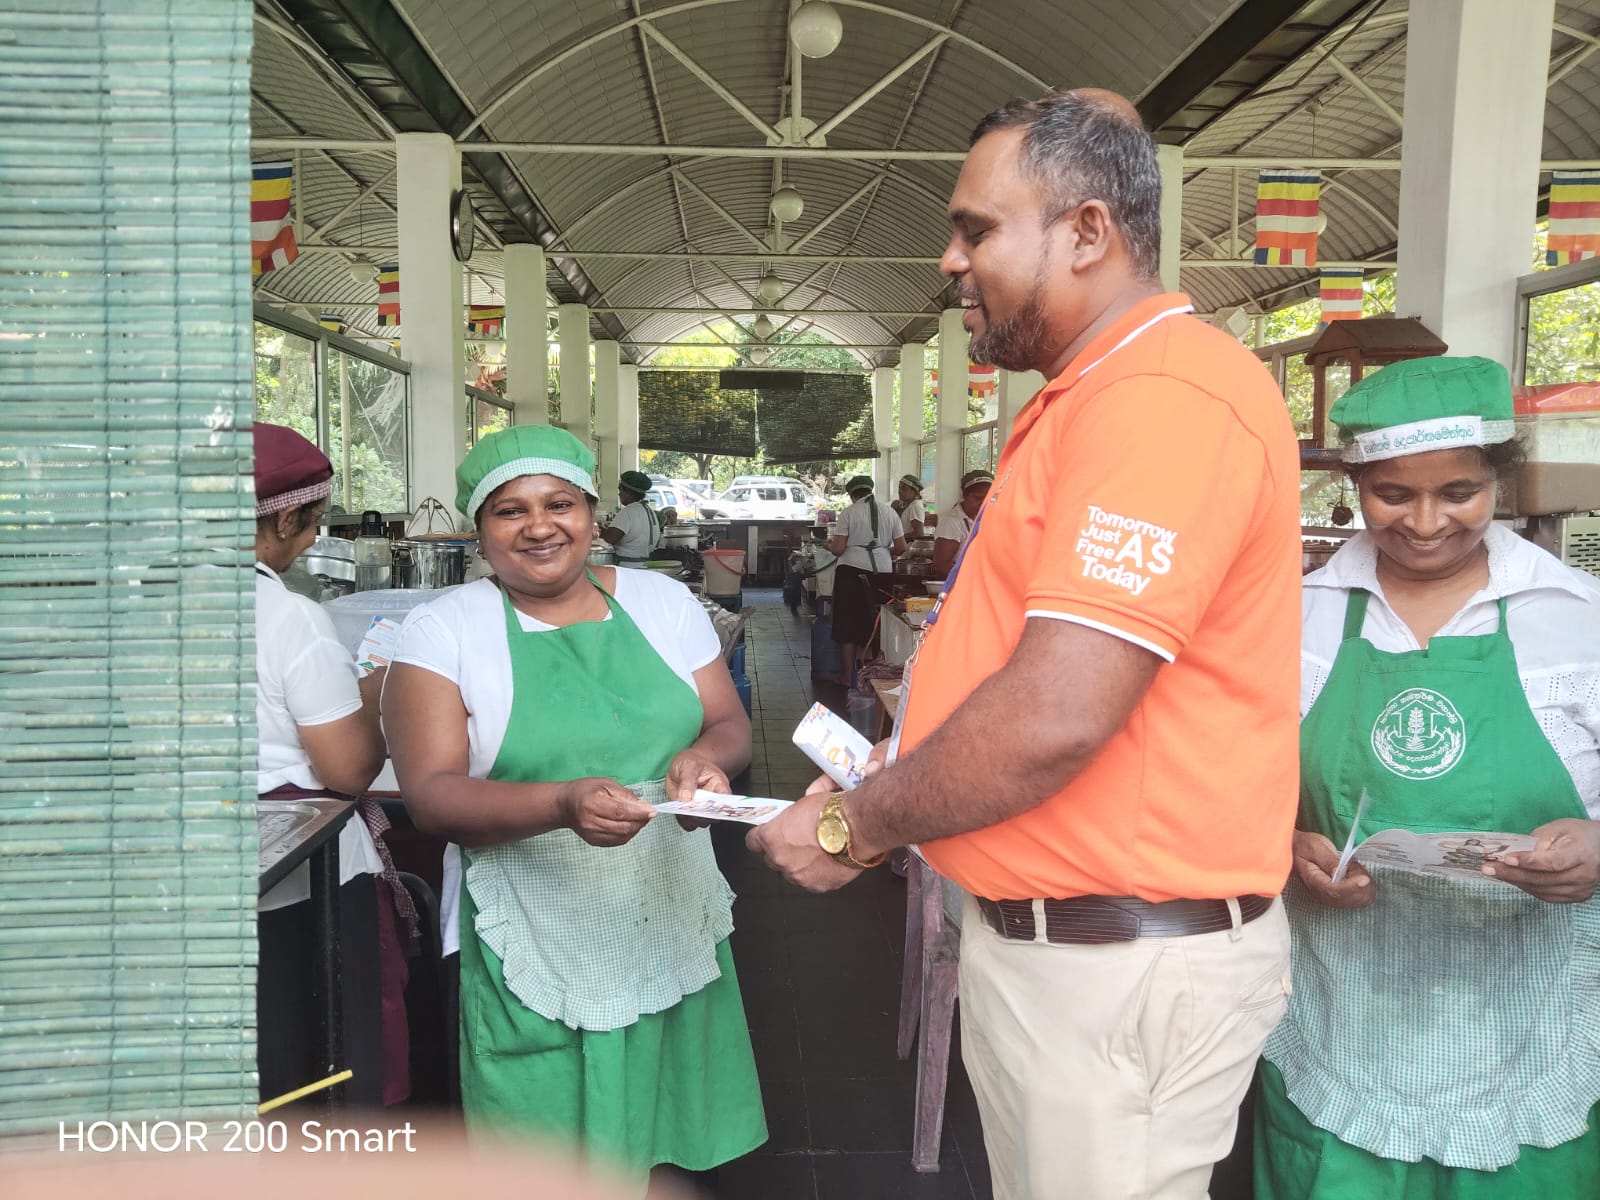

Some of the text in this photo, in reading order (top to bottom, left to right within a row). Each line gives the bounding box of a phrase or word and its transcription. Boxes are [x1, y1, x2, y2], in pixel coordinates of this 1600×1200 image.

[1081, 523, 1121, 544] Just
[1087, 505, 1177, 545] Tomorrow
[1076, 538, 1115, 560] Free
[1081, 555, 1151, 595] Today
